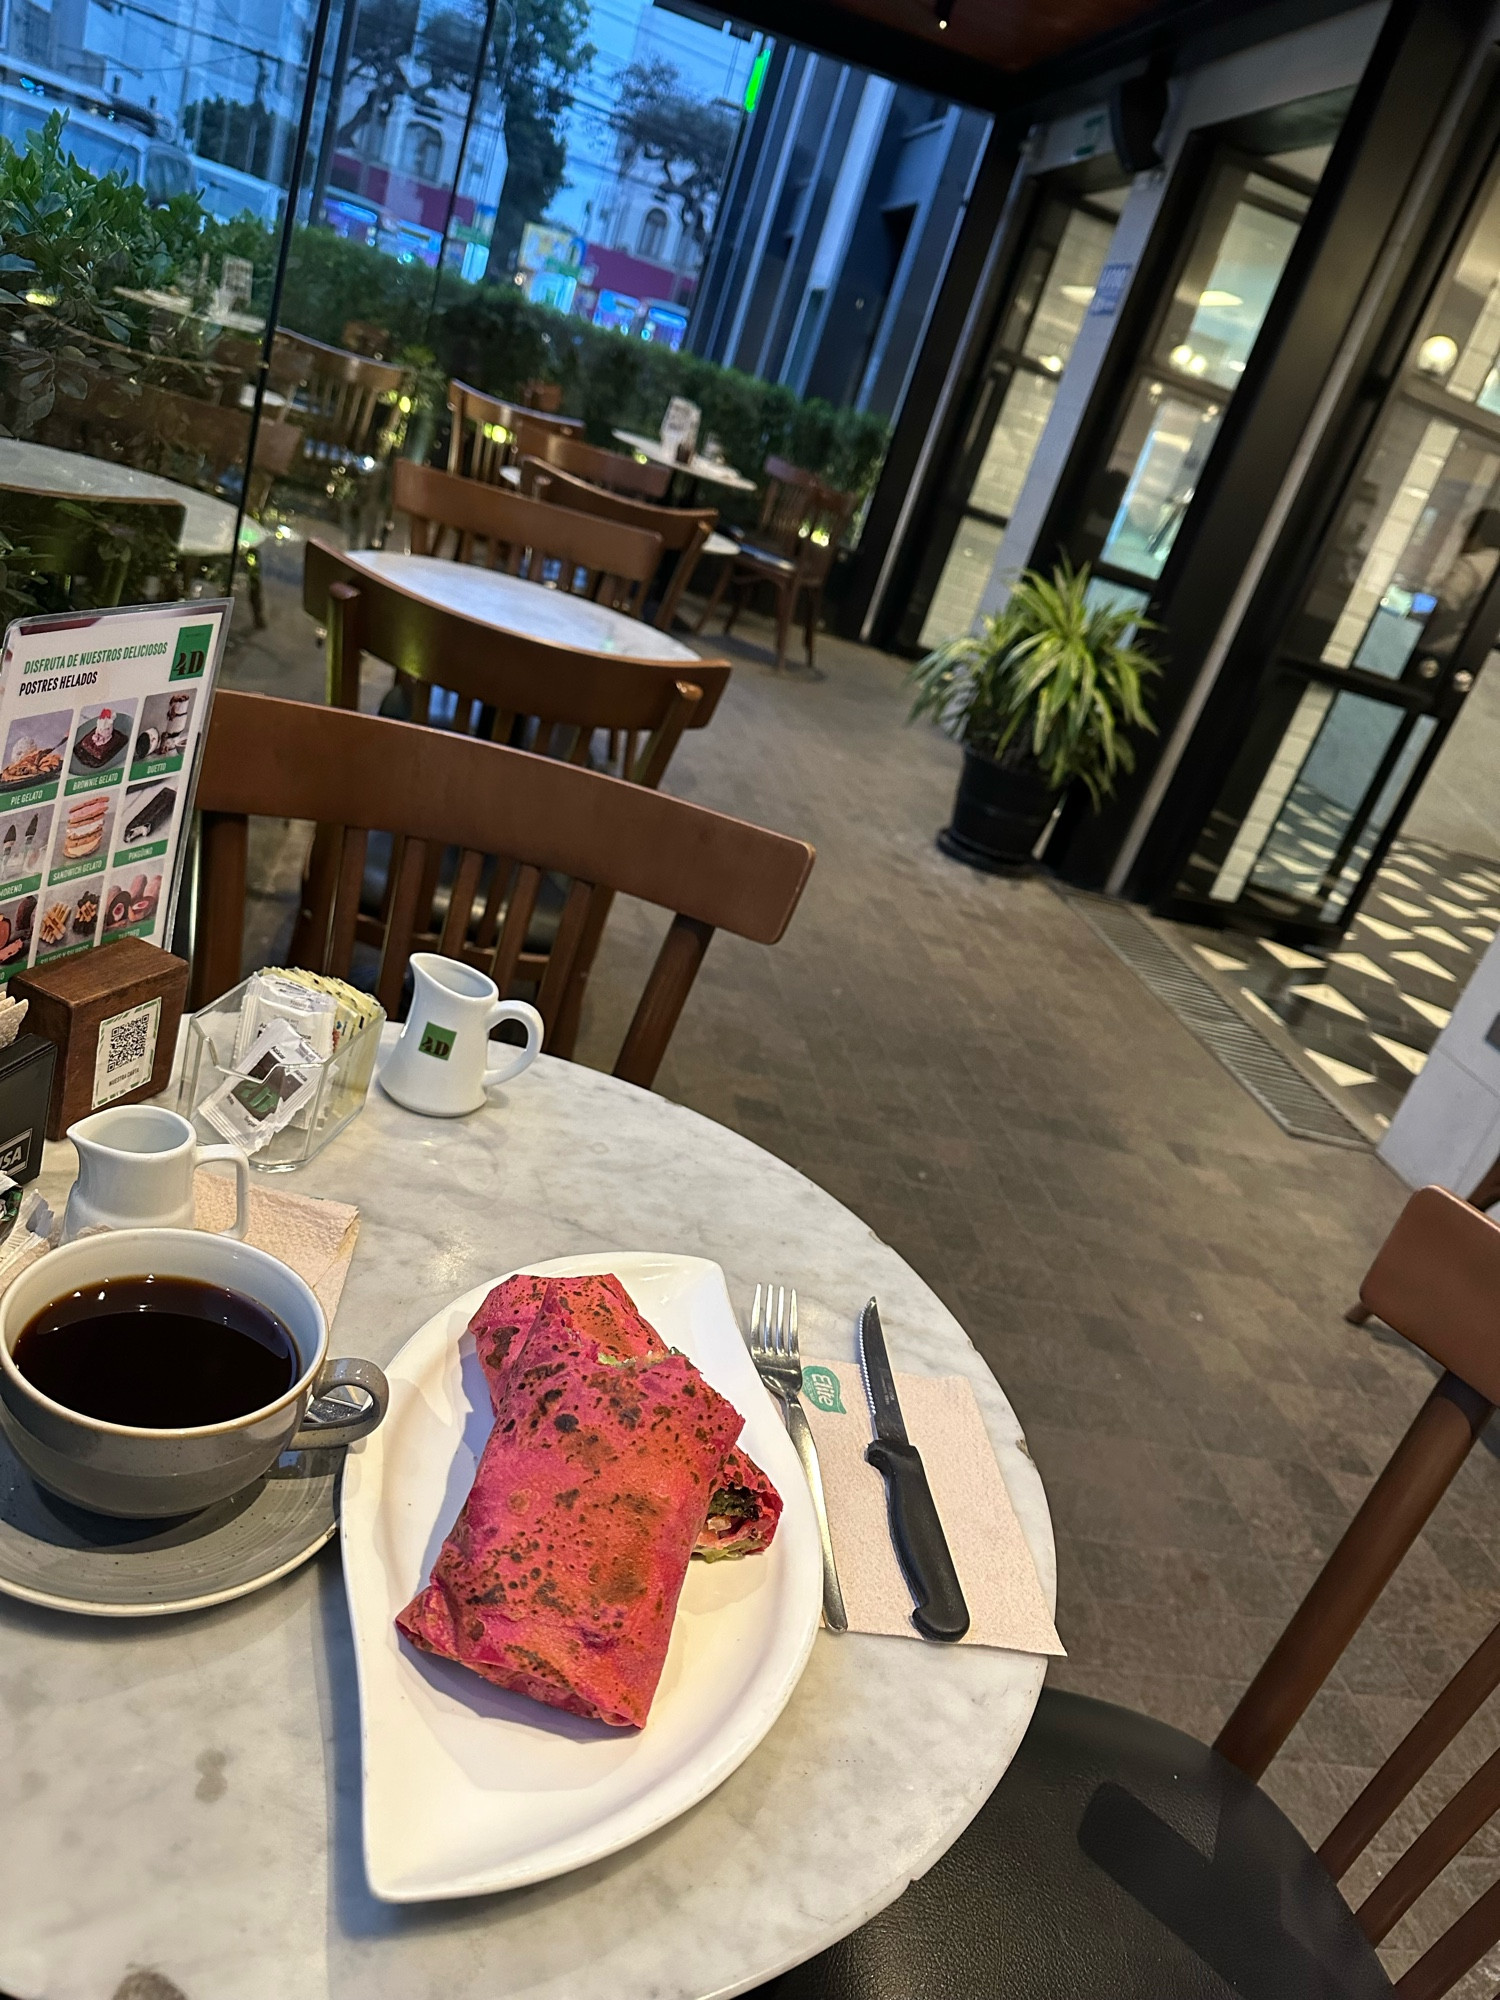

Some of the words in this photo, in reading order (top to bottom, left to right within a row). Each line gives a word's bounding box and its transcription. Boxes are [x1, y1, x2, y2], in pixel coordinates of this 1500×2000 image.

[23, 656, 65, 675] DISFRUTA
[66, 653, 78, 667] DE
[79, 647, 122, 666] NUESTROS
[123, 642, 168, 659] DELICIOSOS
[19, 676, 59, 697] POSTRES
[59, 671, 98, 690] HELADOS
[72, 776, 98, 791] BROWNIE
[98, 772, 119, 785] GELATO
[10, 793, 21, 805] PIE
[21, 789, 43, 802] GELATO
[53, 863, 83, 881] SANDWICH
[83, 859, 103, 874] GELATO
[811, 1373, 836, 1407] Elite
